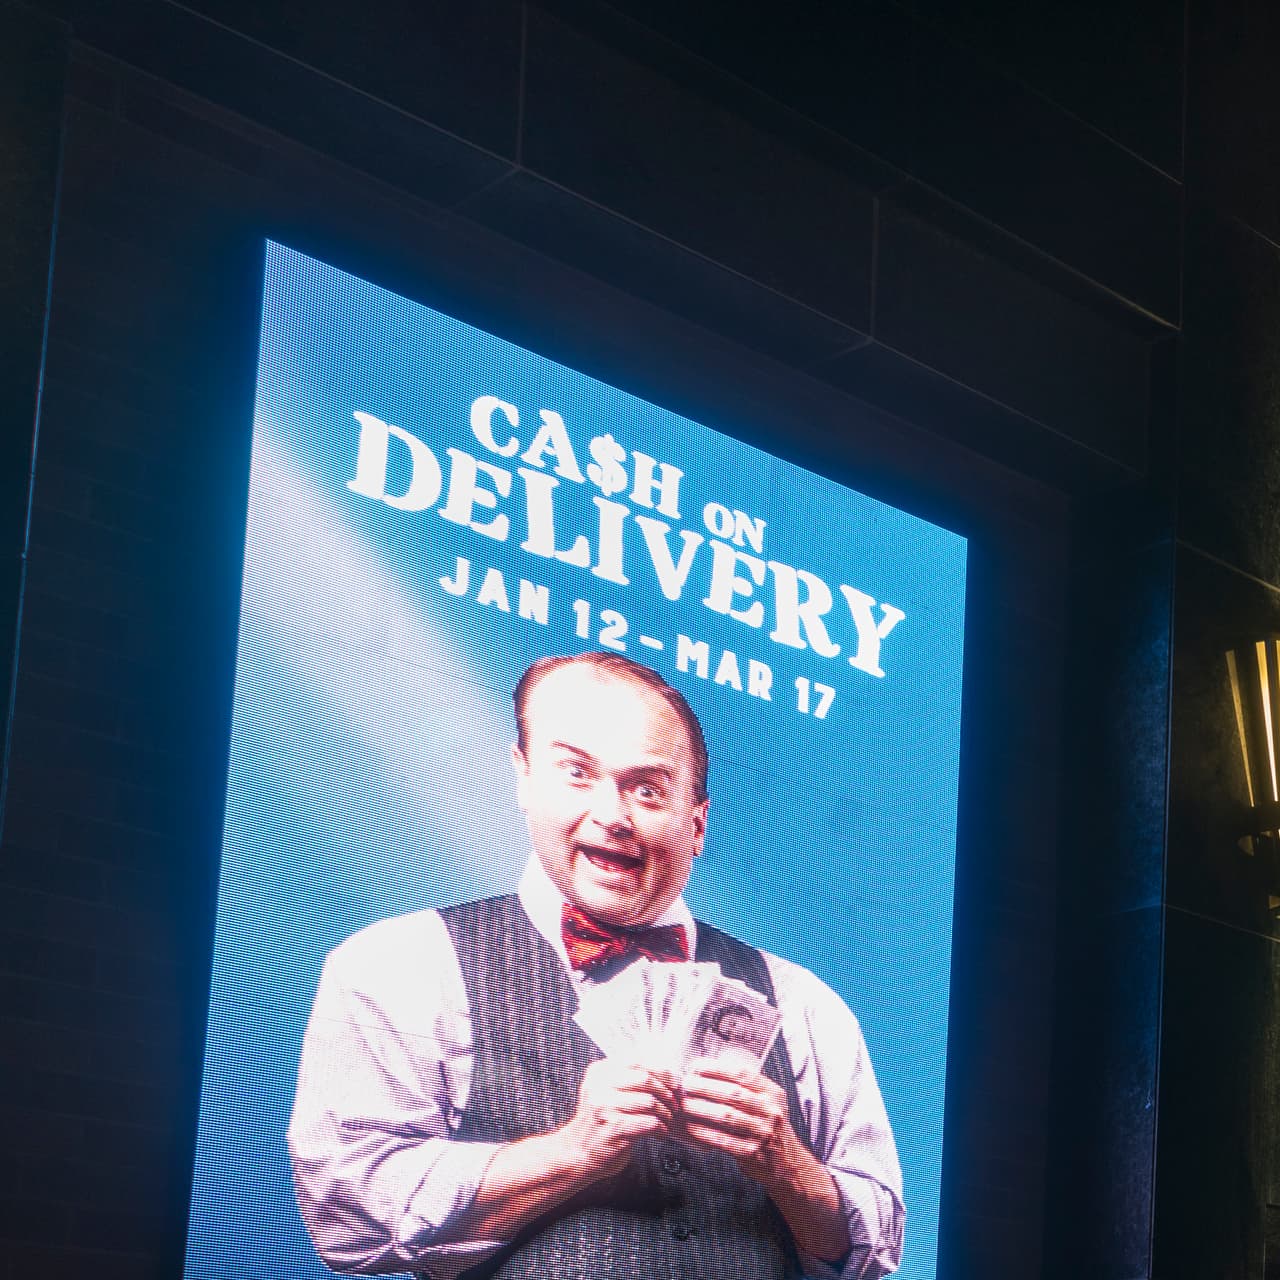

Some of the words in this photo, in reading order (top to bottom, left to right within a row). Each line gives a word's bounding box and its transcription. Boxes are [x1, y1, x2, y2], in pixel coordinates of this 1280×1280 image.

[346, 410, 906, 679] DELIVERY
[469, 394, 685, 520] CA$H
[702, 500, 767, 556] ON
[438, 556, 551, 626] JAN
[794, 675, 837, 720] 17
